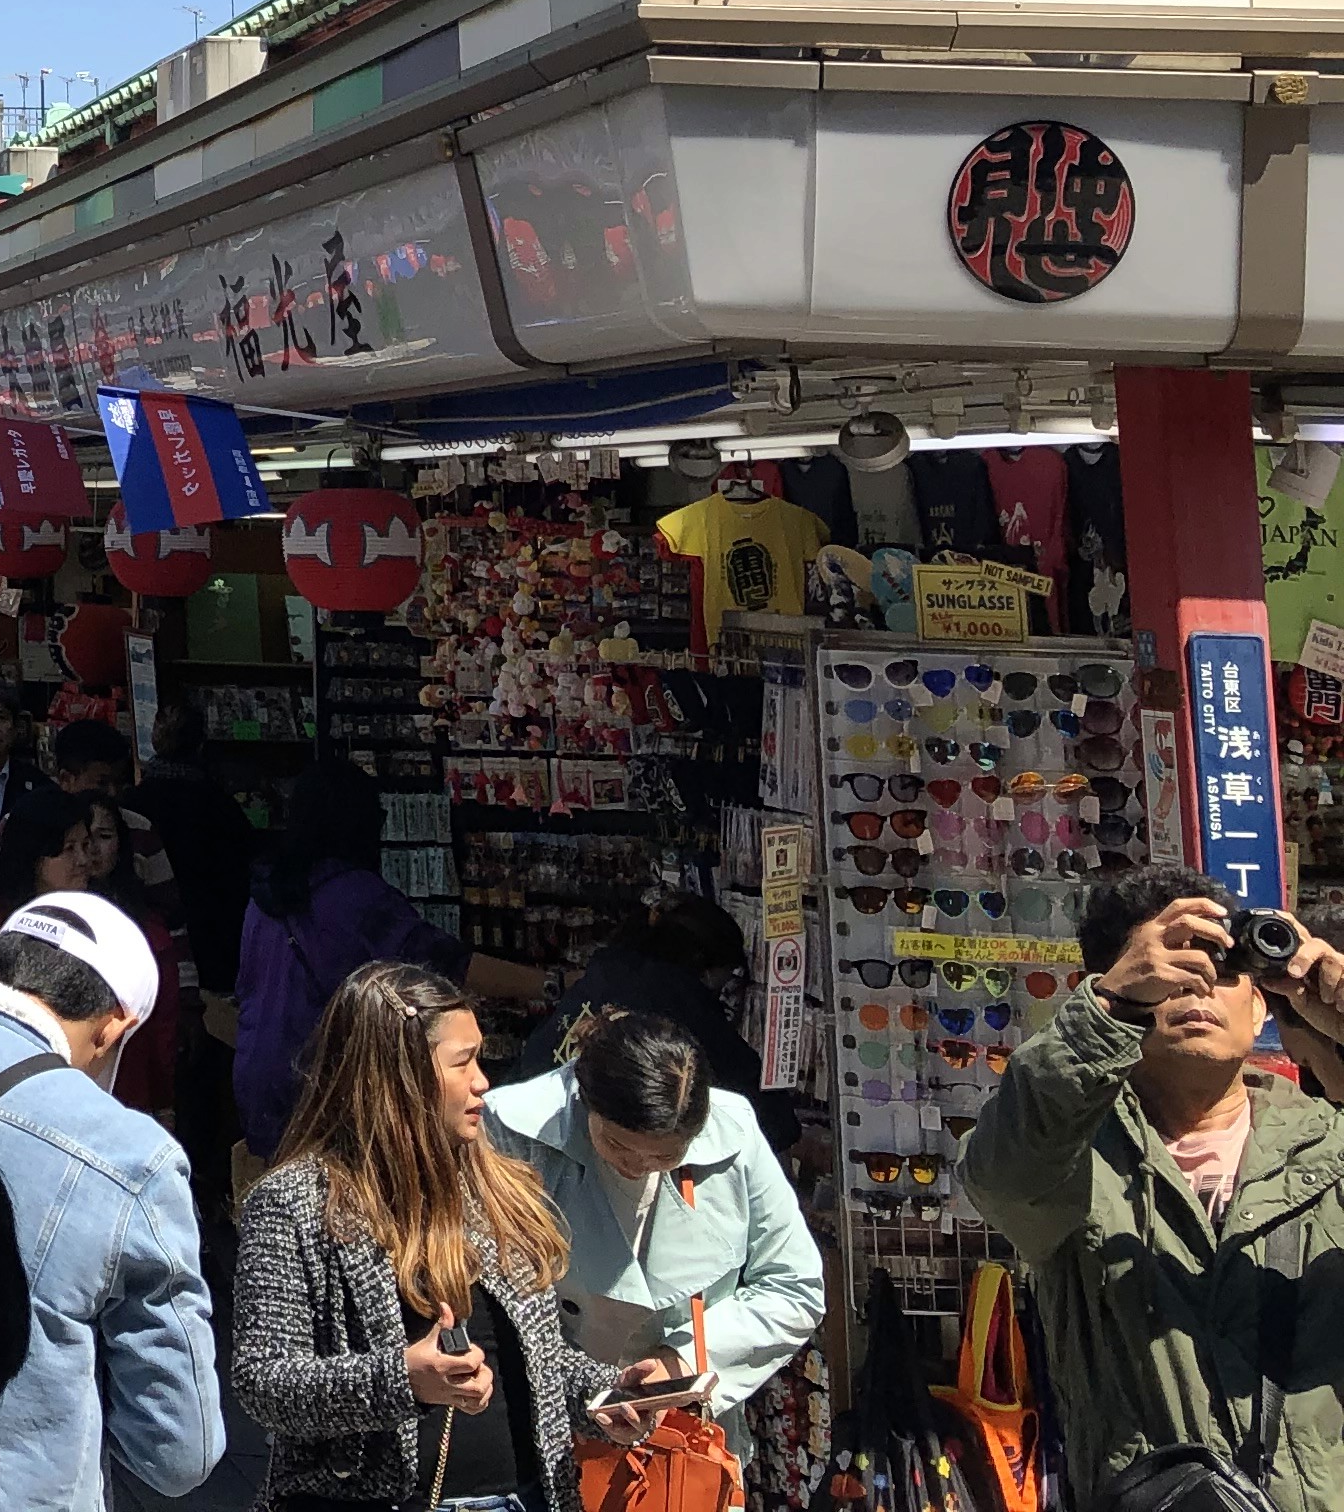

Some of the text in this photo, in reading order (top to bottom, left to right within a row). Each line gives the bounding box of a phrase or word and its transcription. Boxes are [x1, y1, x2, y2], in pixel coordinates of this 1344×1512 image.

[984, 563, 1005, 580] NOT
[941, 577, 999, 592] サングラス
[925, 593, 1016, 611] SUNGLASSE
[1221, 660, 1242, 714] 台東区
[1200, 661, 1217, 736] TAITO CITY
[1206, 774, 1223, 842] ASAKUSA
[17, 916, 58, 936] ATLANTA
